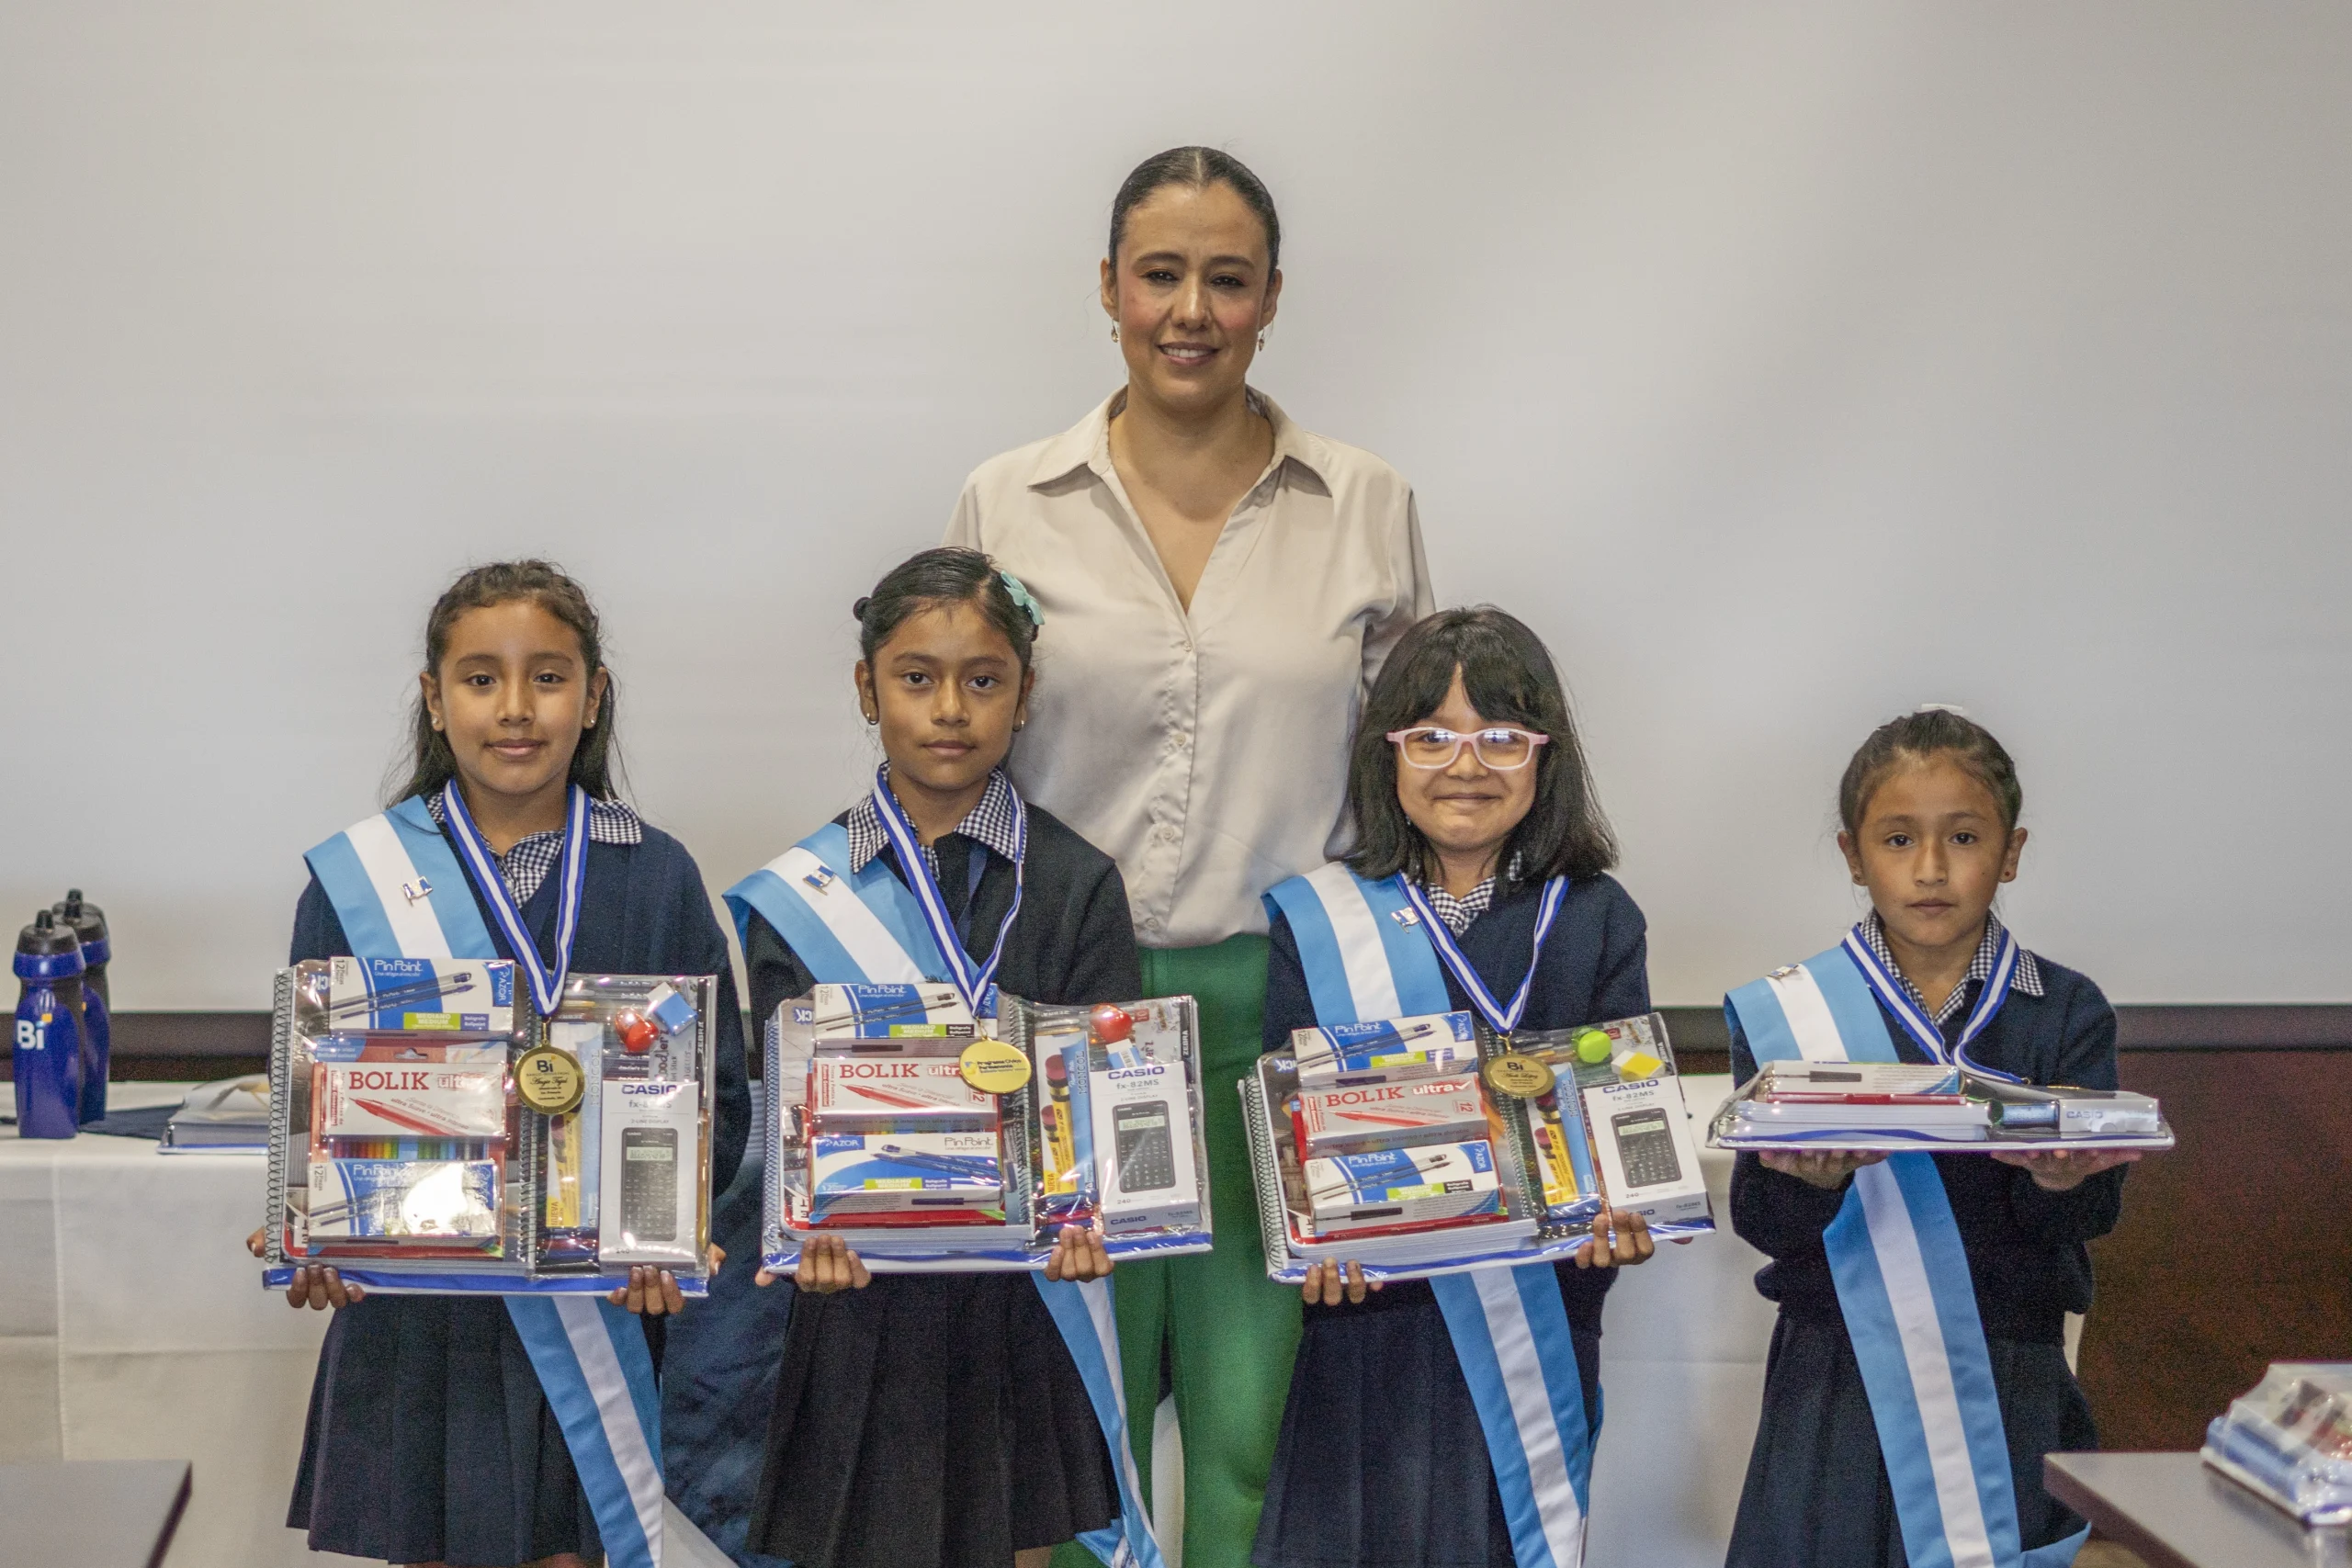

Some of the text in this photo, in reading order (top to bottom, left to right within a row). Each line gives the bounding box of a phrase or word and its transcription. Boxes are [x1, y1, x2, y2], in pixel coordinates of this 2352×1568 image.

[374, 960, 424, 972] Pin Point
[498, 976, 507, 1001] AZOR
[858, 985, 907, 994] Pin Point
[1334, 1025, 1353, 1033] Pin
[1353, 1022, 1383, 1032] Point
[17, 1020, 44, 1050] Bi
[537, 1059, 554, 1073] Bi
[840, 1064, 919, 1078] BOLIK
[927, 1064, 961, 1077] ultr
[1076, 1050, 1088, 1095] MONGOL
[1506, 1061, 1523, 1071] Bi
[1108, 1066, 1165, 1080] CASIO
[349, 1071, 429, 1090] BOLIK
[1116, 1078, 1159, 1089] fx-82MS
[1602, 1079, 1659, 1094] CASIO
[1413, 1083, 1454, 1096] ultra
[1612, 1090, 1655, 1101] fx-82MS
[1326, 1086, 1405, 1107] BOLIK
[1460, 1101, 1474, 1112] 12
[2065, 1111, 2104, 1119] CASIO
[944, 1136, 993, 1146] Pin Point
[1348, 1156, 1368, 1165] Pin
[1368, 1152, 1397, 1162] Point
[1111, 1215, 1148, 1225] CASIO
